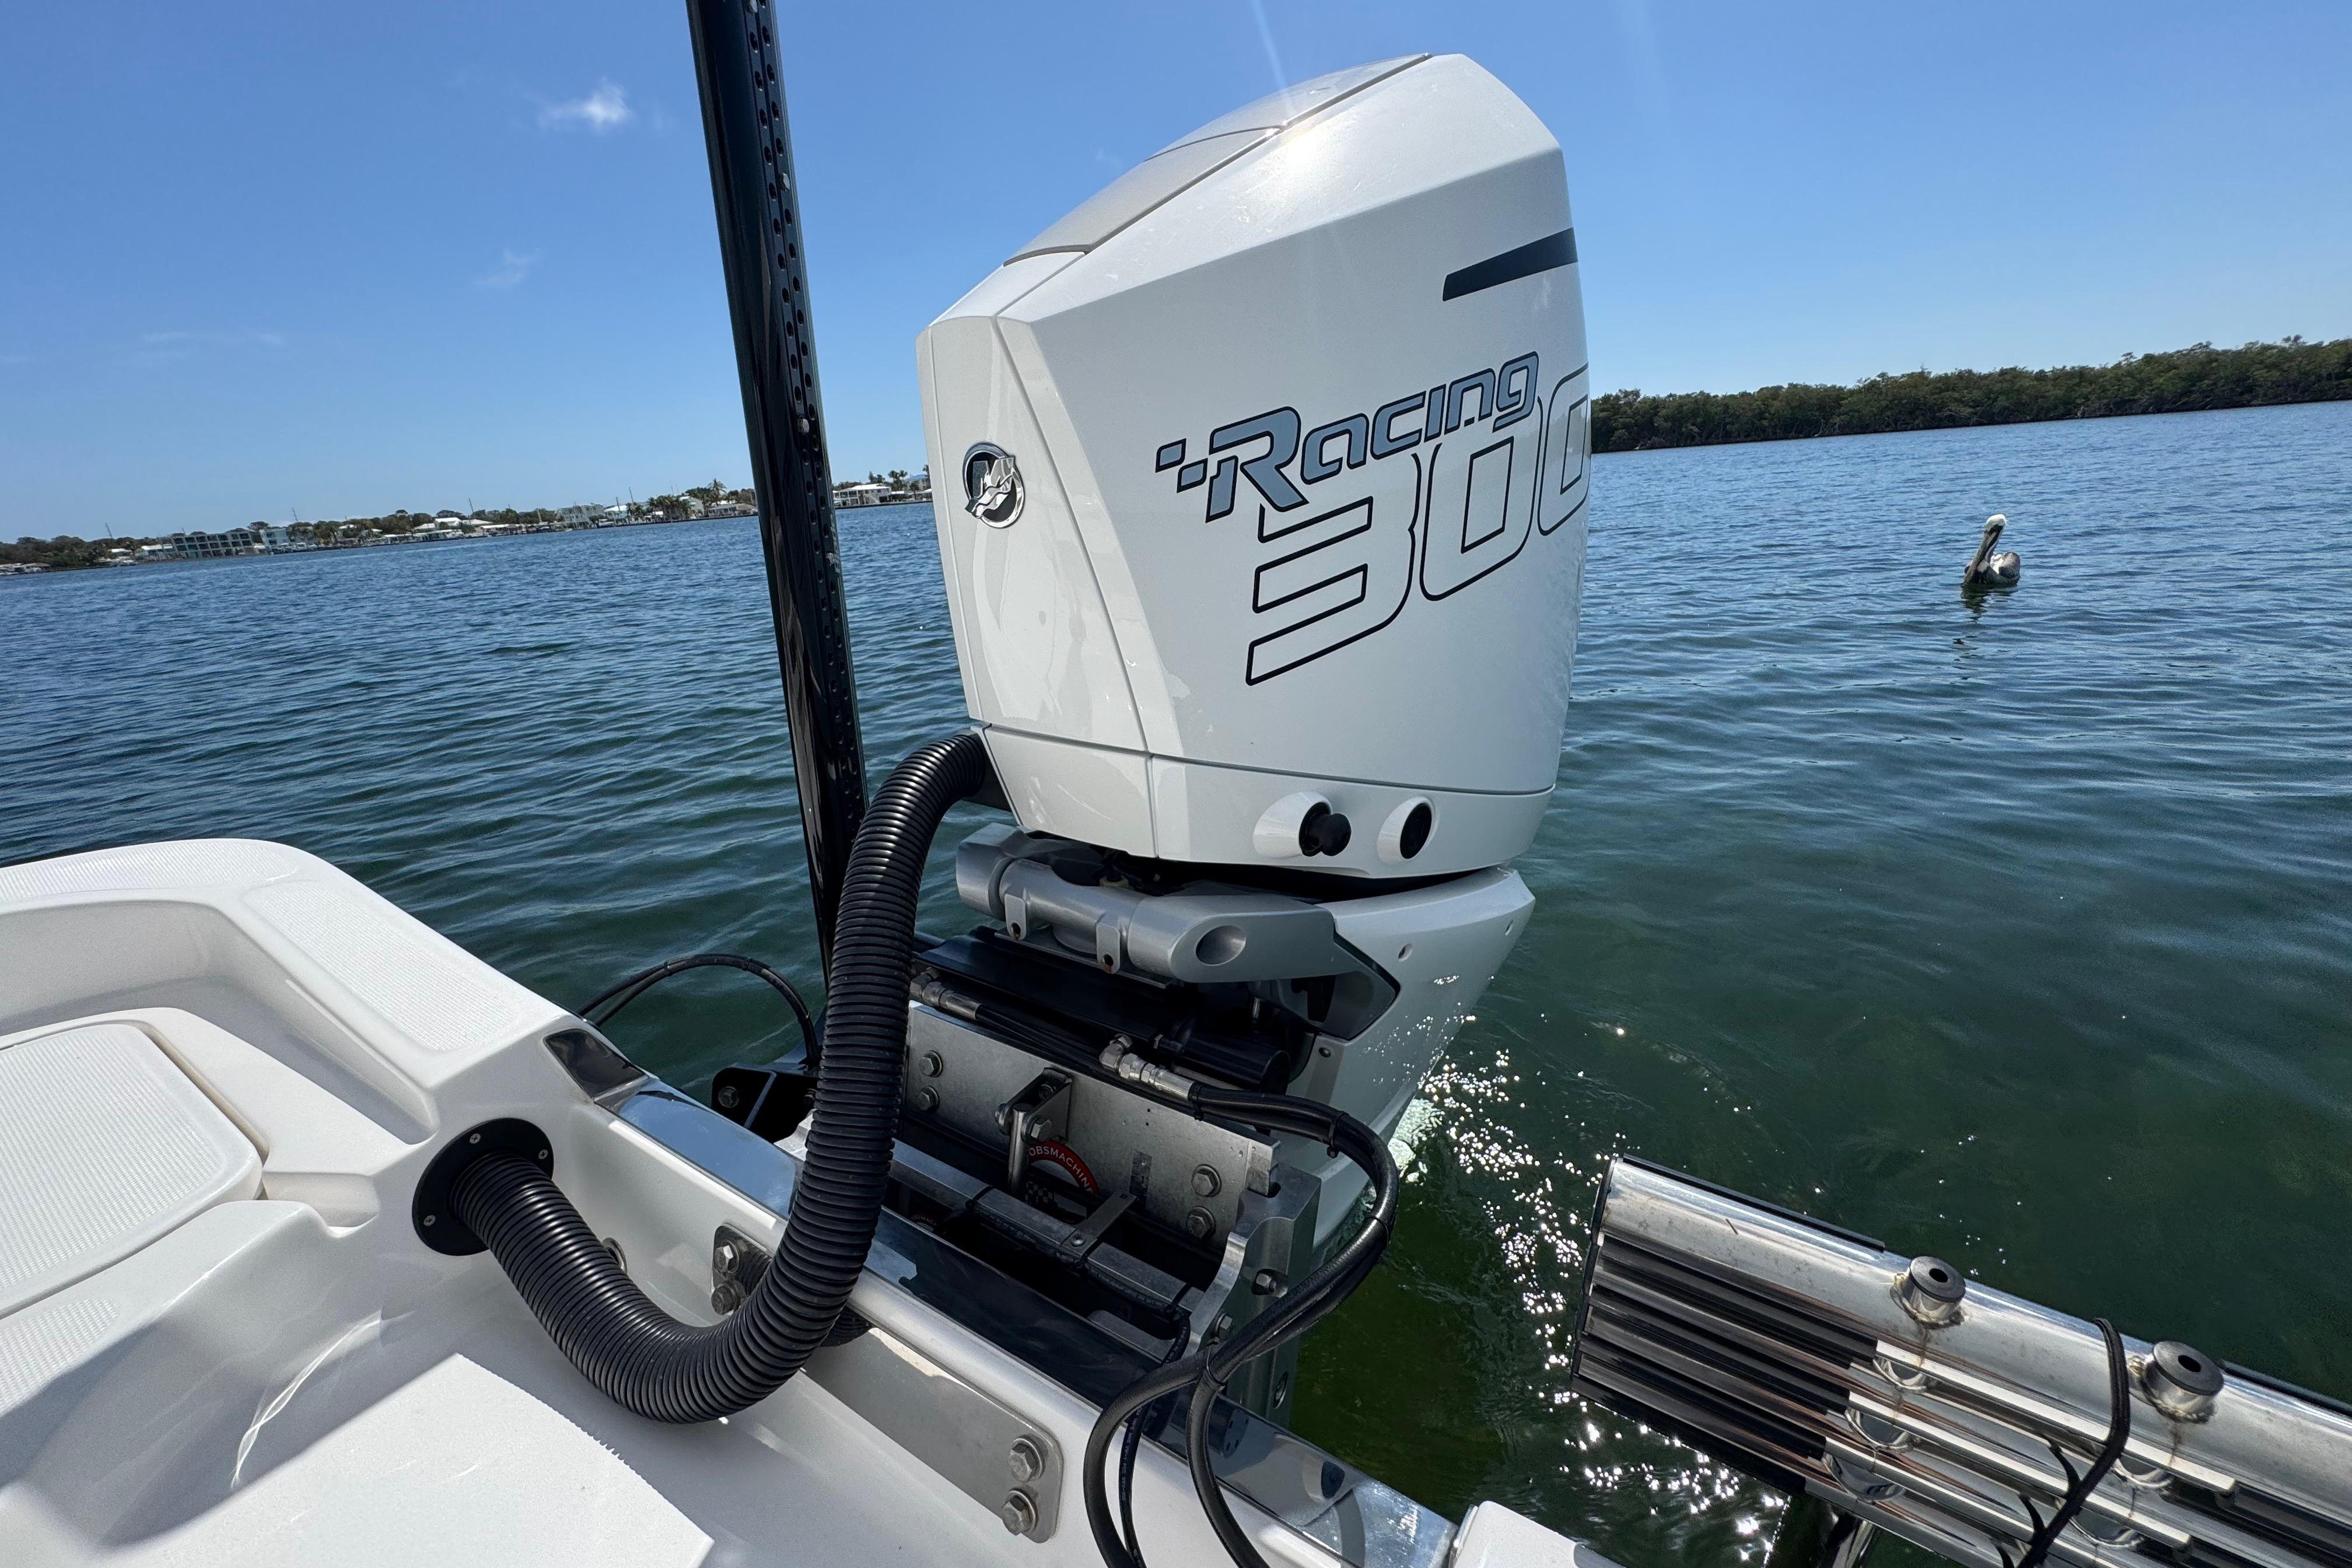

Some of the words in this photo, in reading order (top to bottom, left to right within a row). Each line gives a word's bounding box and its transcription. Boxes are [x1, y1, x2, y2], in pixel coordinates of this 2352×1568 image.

[1205, 351, 1539, 523] Racing
[1245, 363, 1590, 687] 300
[1028, 1146, 1094, 1194] OBSMACHINE
